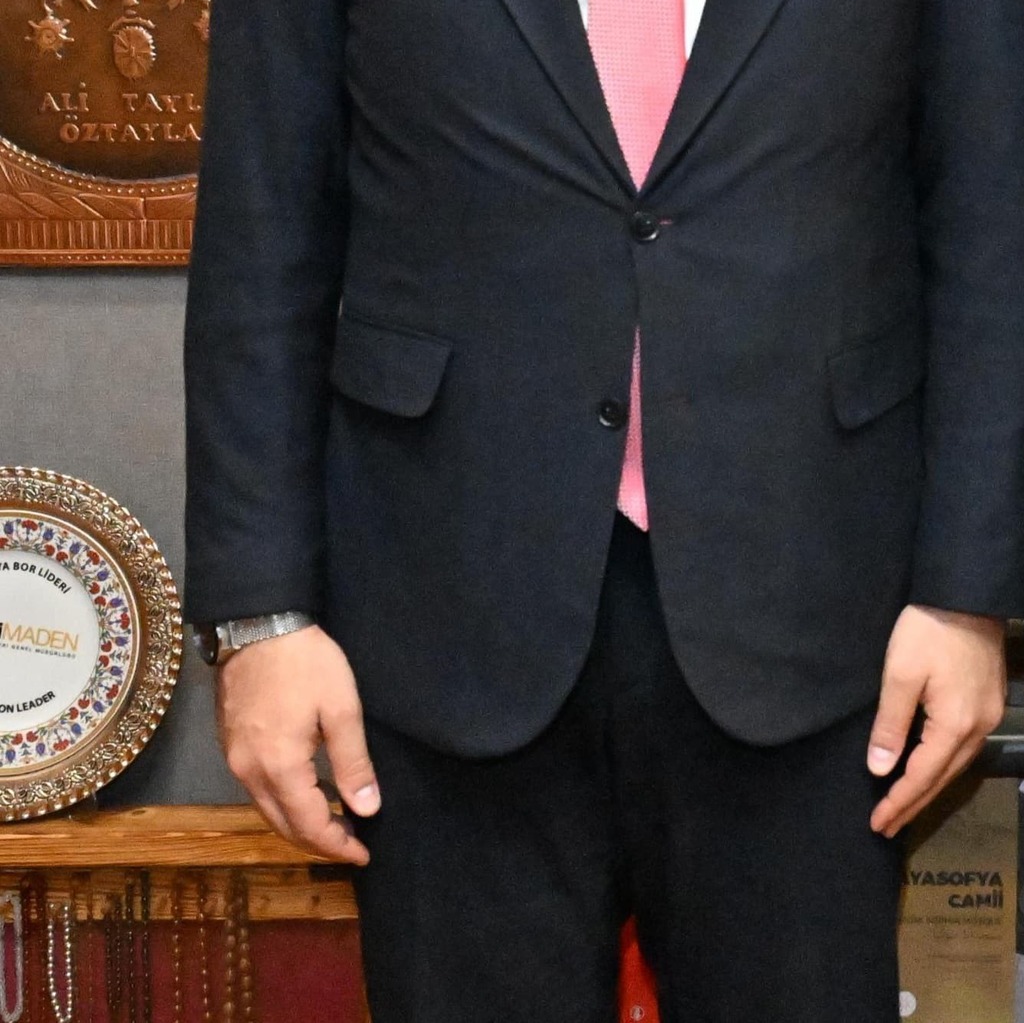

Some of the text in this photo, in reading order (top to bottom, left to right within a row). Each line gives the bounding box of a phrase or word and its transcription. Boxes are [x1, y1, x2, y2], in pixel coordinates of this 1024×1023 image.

[13, 561, 37, 574] BOR
[37, 567, 72, 594] LİDERİ
[16, 690, 56, 713] LEADER
